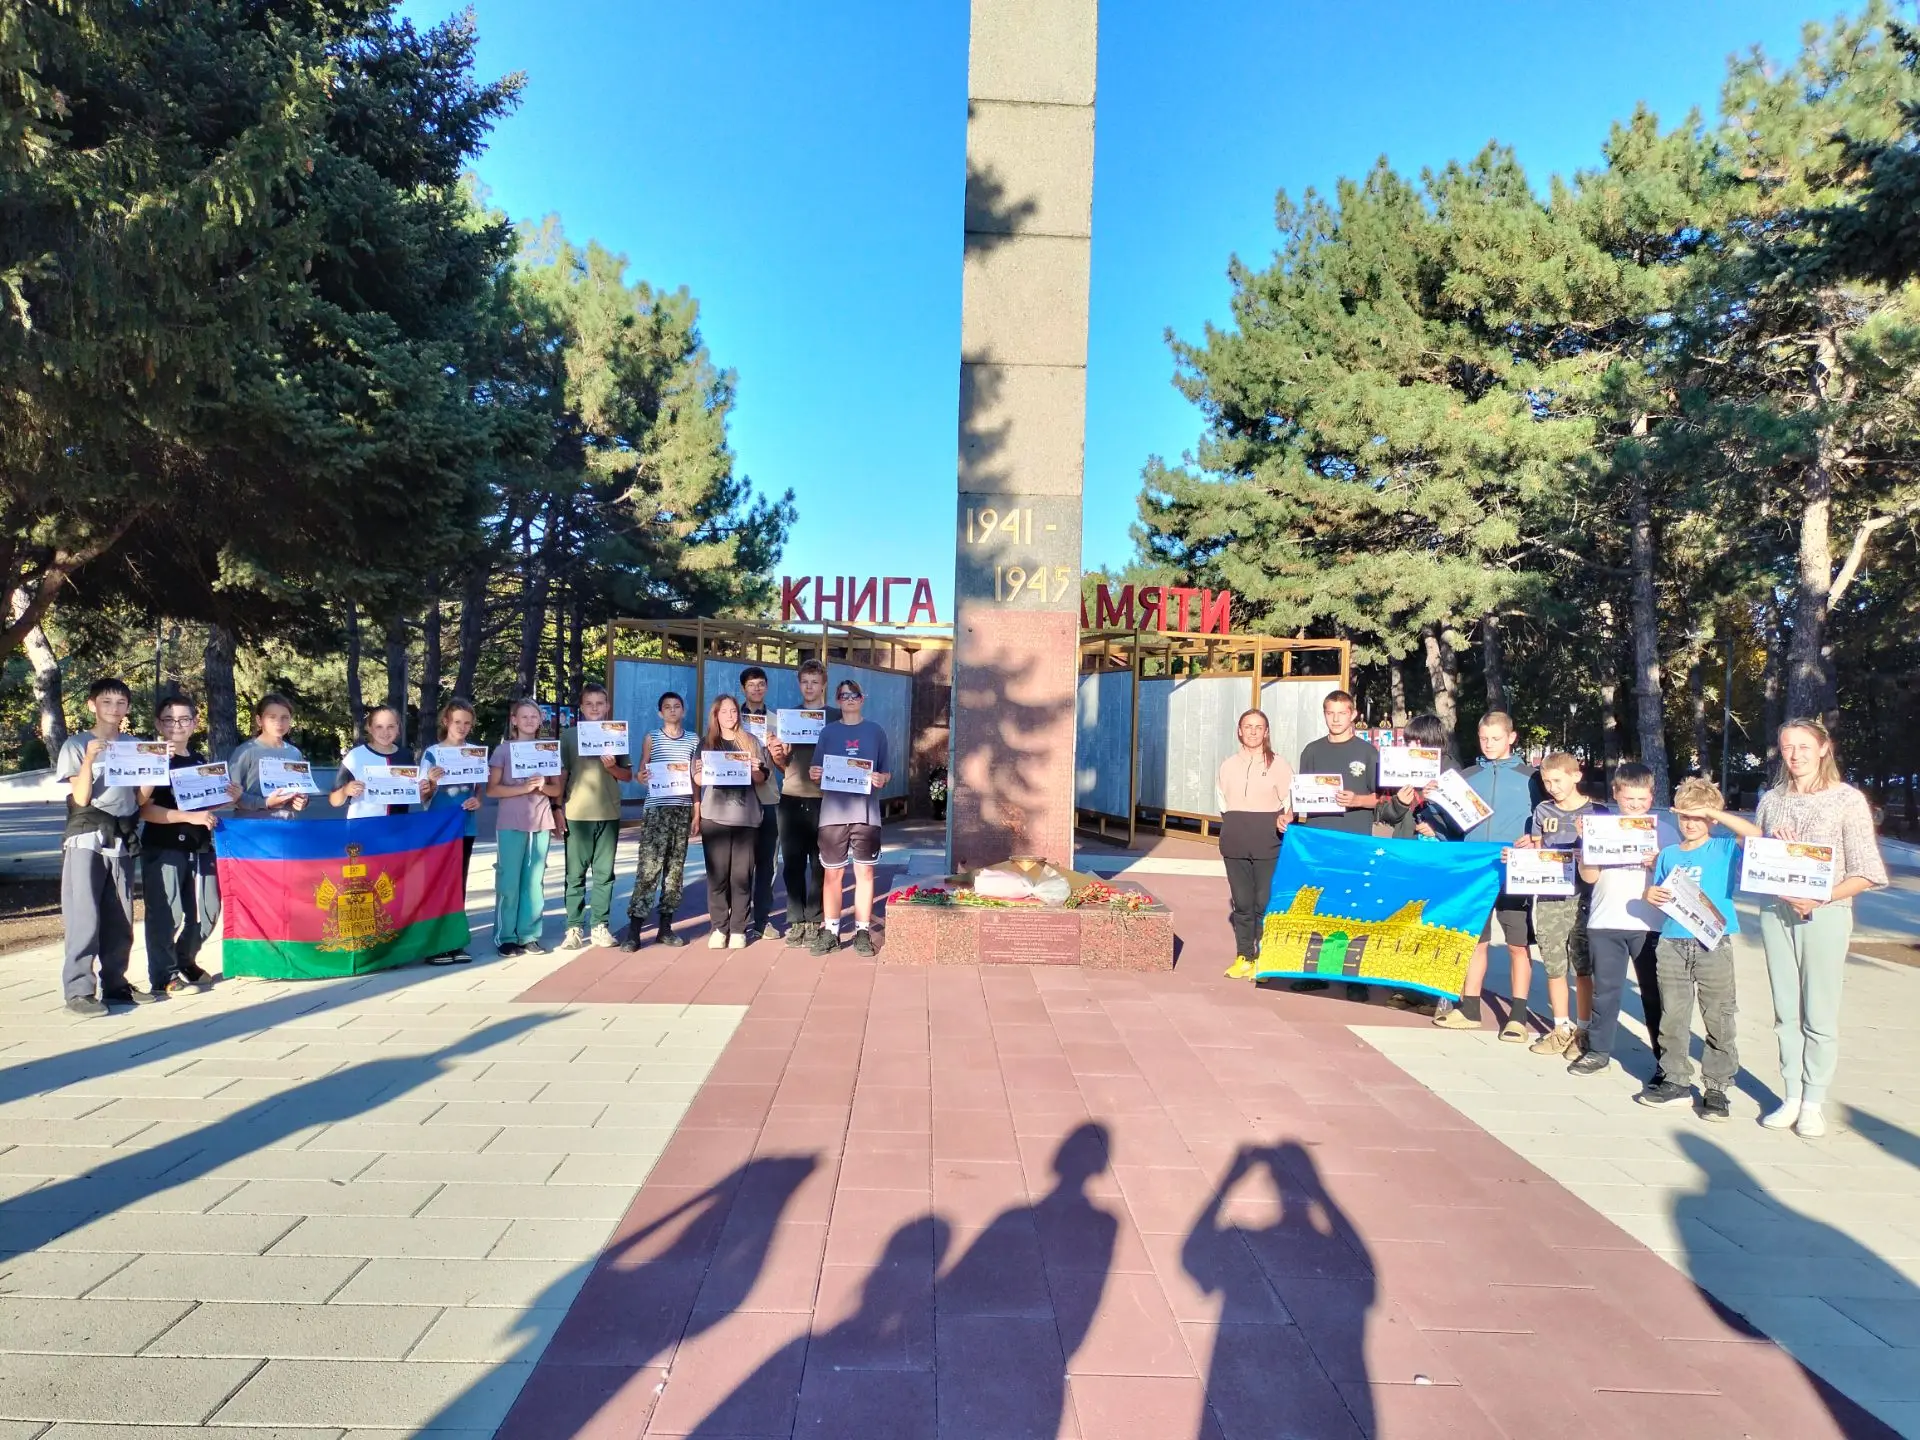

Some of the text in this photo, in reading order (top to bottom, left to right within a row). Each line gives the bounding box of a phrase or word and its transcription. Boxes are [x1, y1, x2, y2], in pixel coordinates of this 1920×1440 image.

[967, 508, 1032, 545] 1941
[994, 566, 1071, 603] 1945
[781, 575, 938, 624] КНИГА
[1080, 583, 1232, 635] МЯТИ
[1543, 817, 1559, 833] 10
